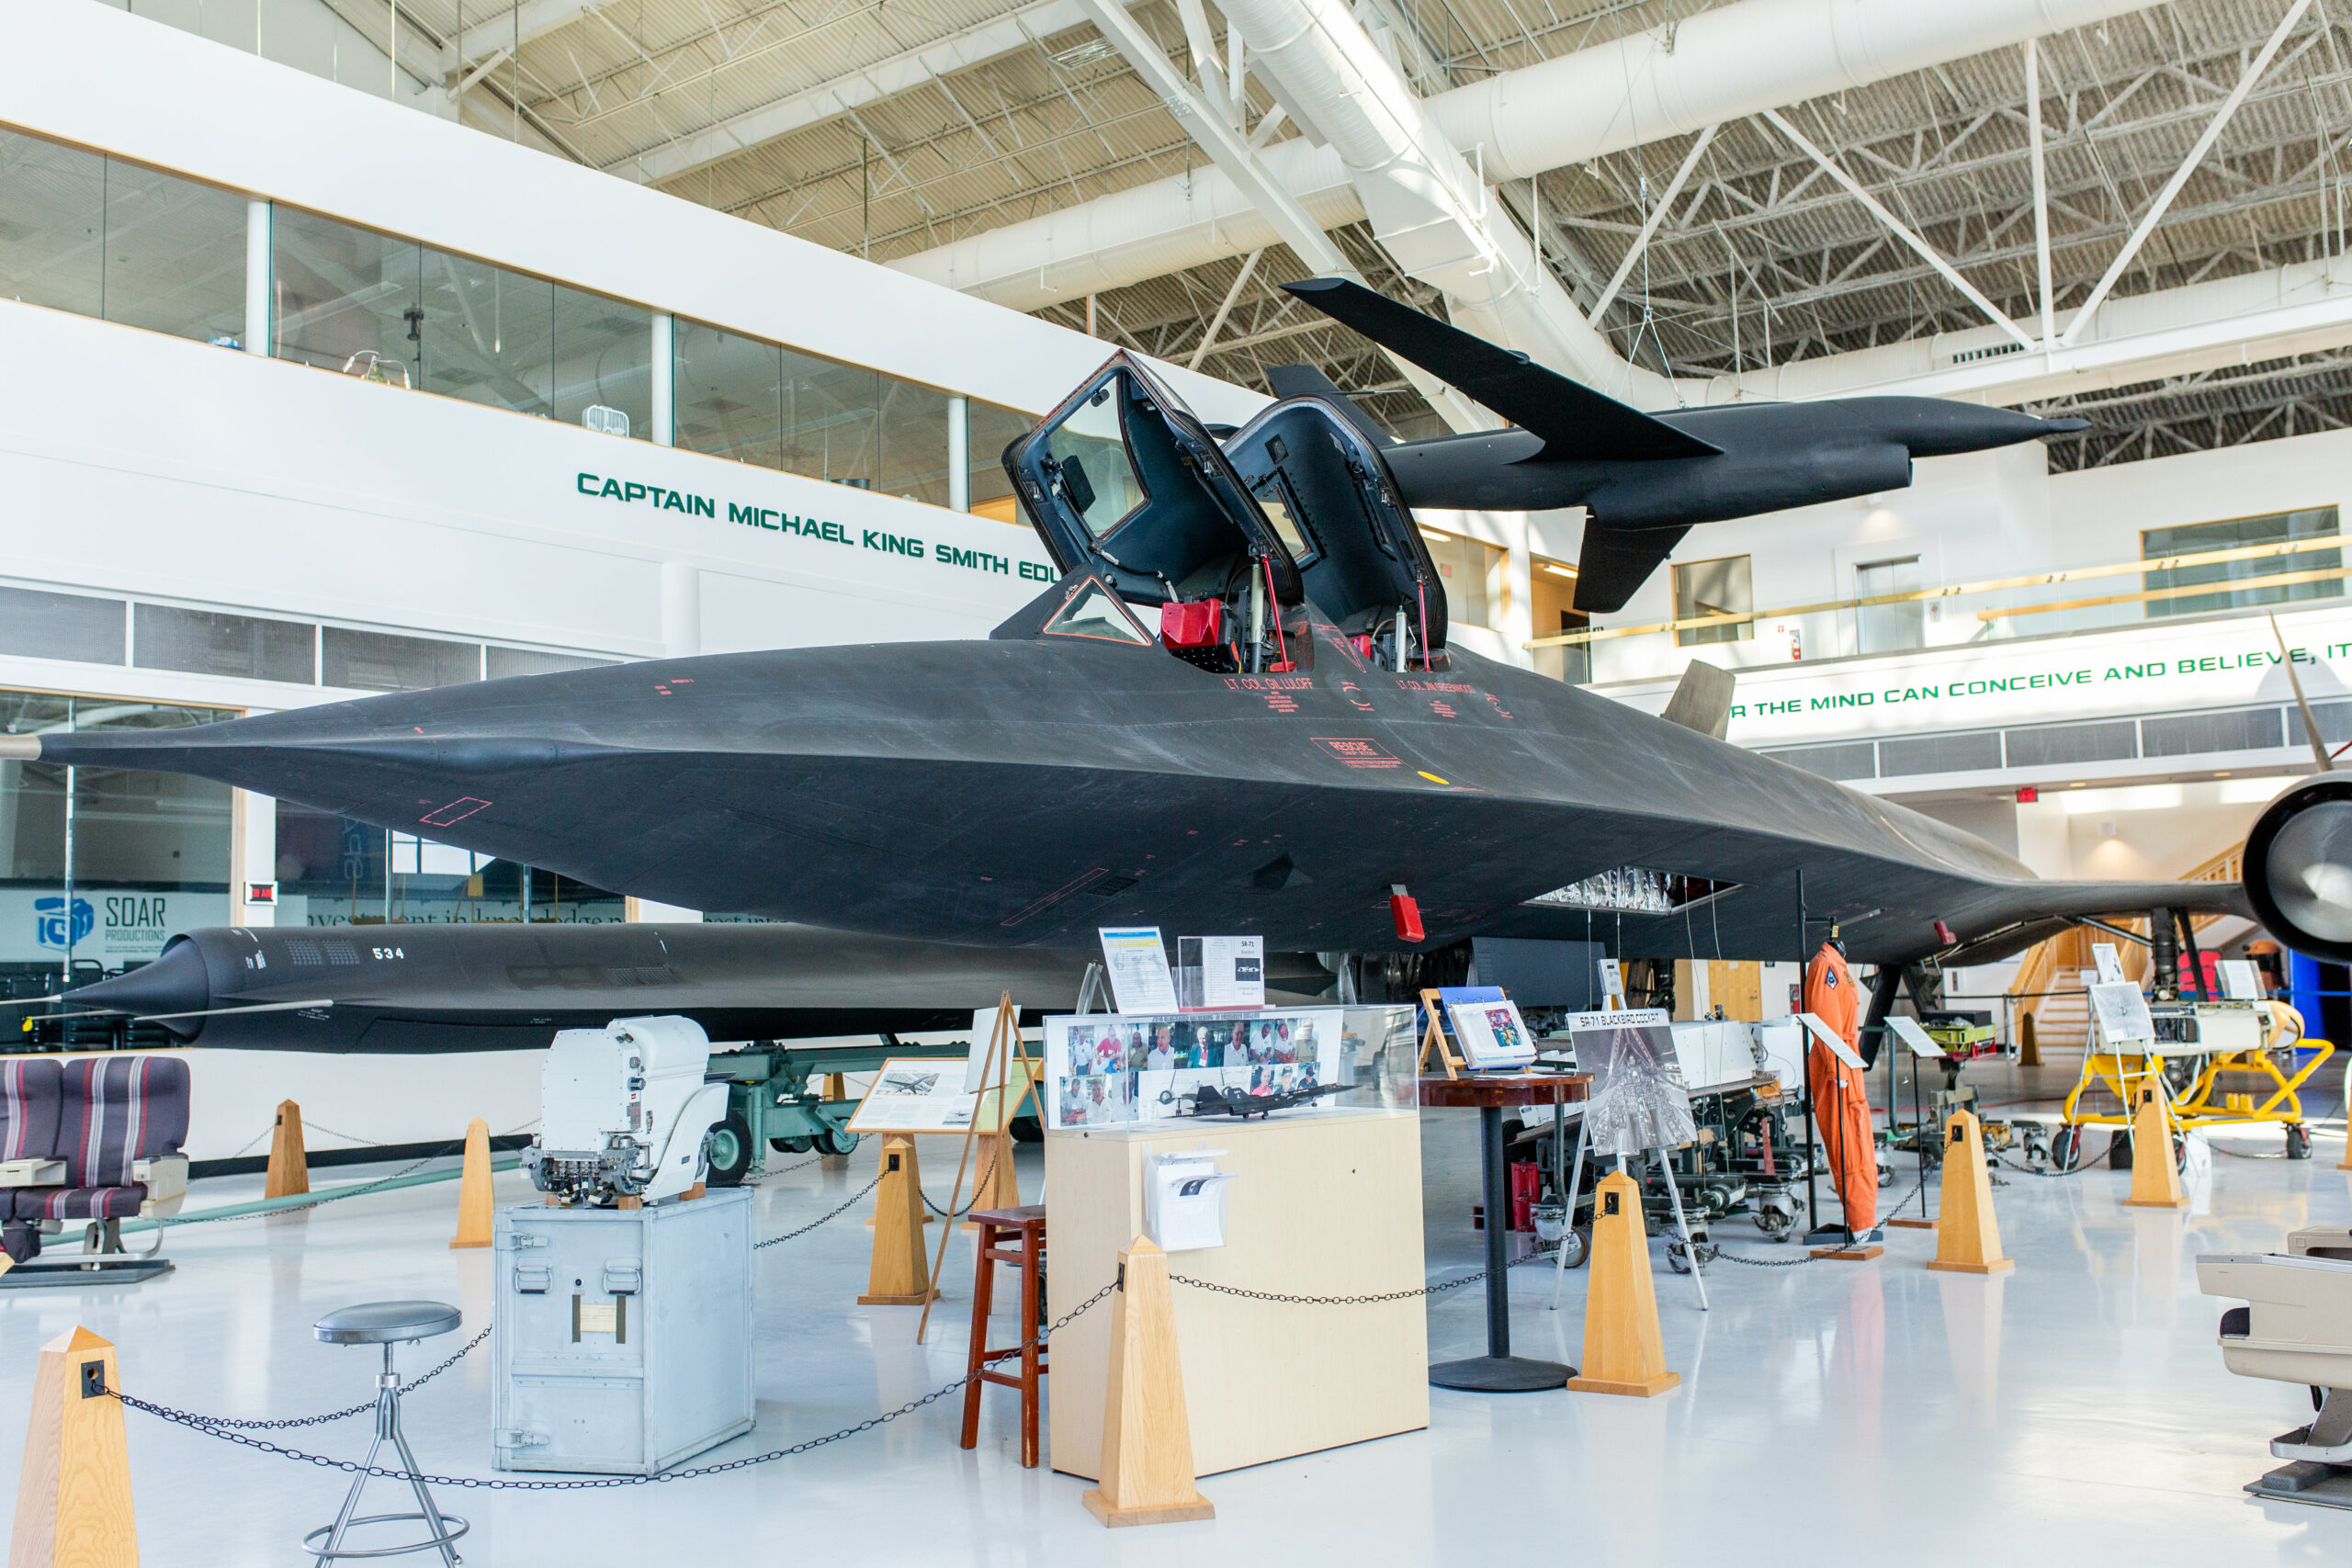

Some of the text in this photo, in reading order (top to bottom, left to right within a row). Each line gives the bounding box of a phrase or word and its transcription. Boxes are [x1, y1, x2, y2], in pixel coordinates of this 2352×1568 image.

[577, 472, 715, 518] CAPTAIN
[729, 502, 854, 546] MICHAEL
[863, 529, 924, 558] KING
[935, 544, 1009, 574] SMITH
[1754, 699, 1802, 716] THE
[1811, 693, 1875, 711] MIND
[1884, 685, 1939, 704] CAN
[1949, 670, 2092, 696] CONCEIVE
[2104, 661, 2166, 682] AND
[2177, 648, 2316, 674] BELIEVE,
[106, 897, 165, 927] SOAR
[105, 929, 165, 942] PRODUCTIONS
[372, 947, 405, 960] 534
[1579, 1016, 1600, 1027] SR-71
[1601, 1014, 1635, 1025] BLACKBIRD
